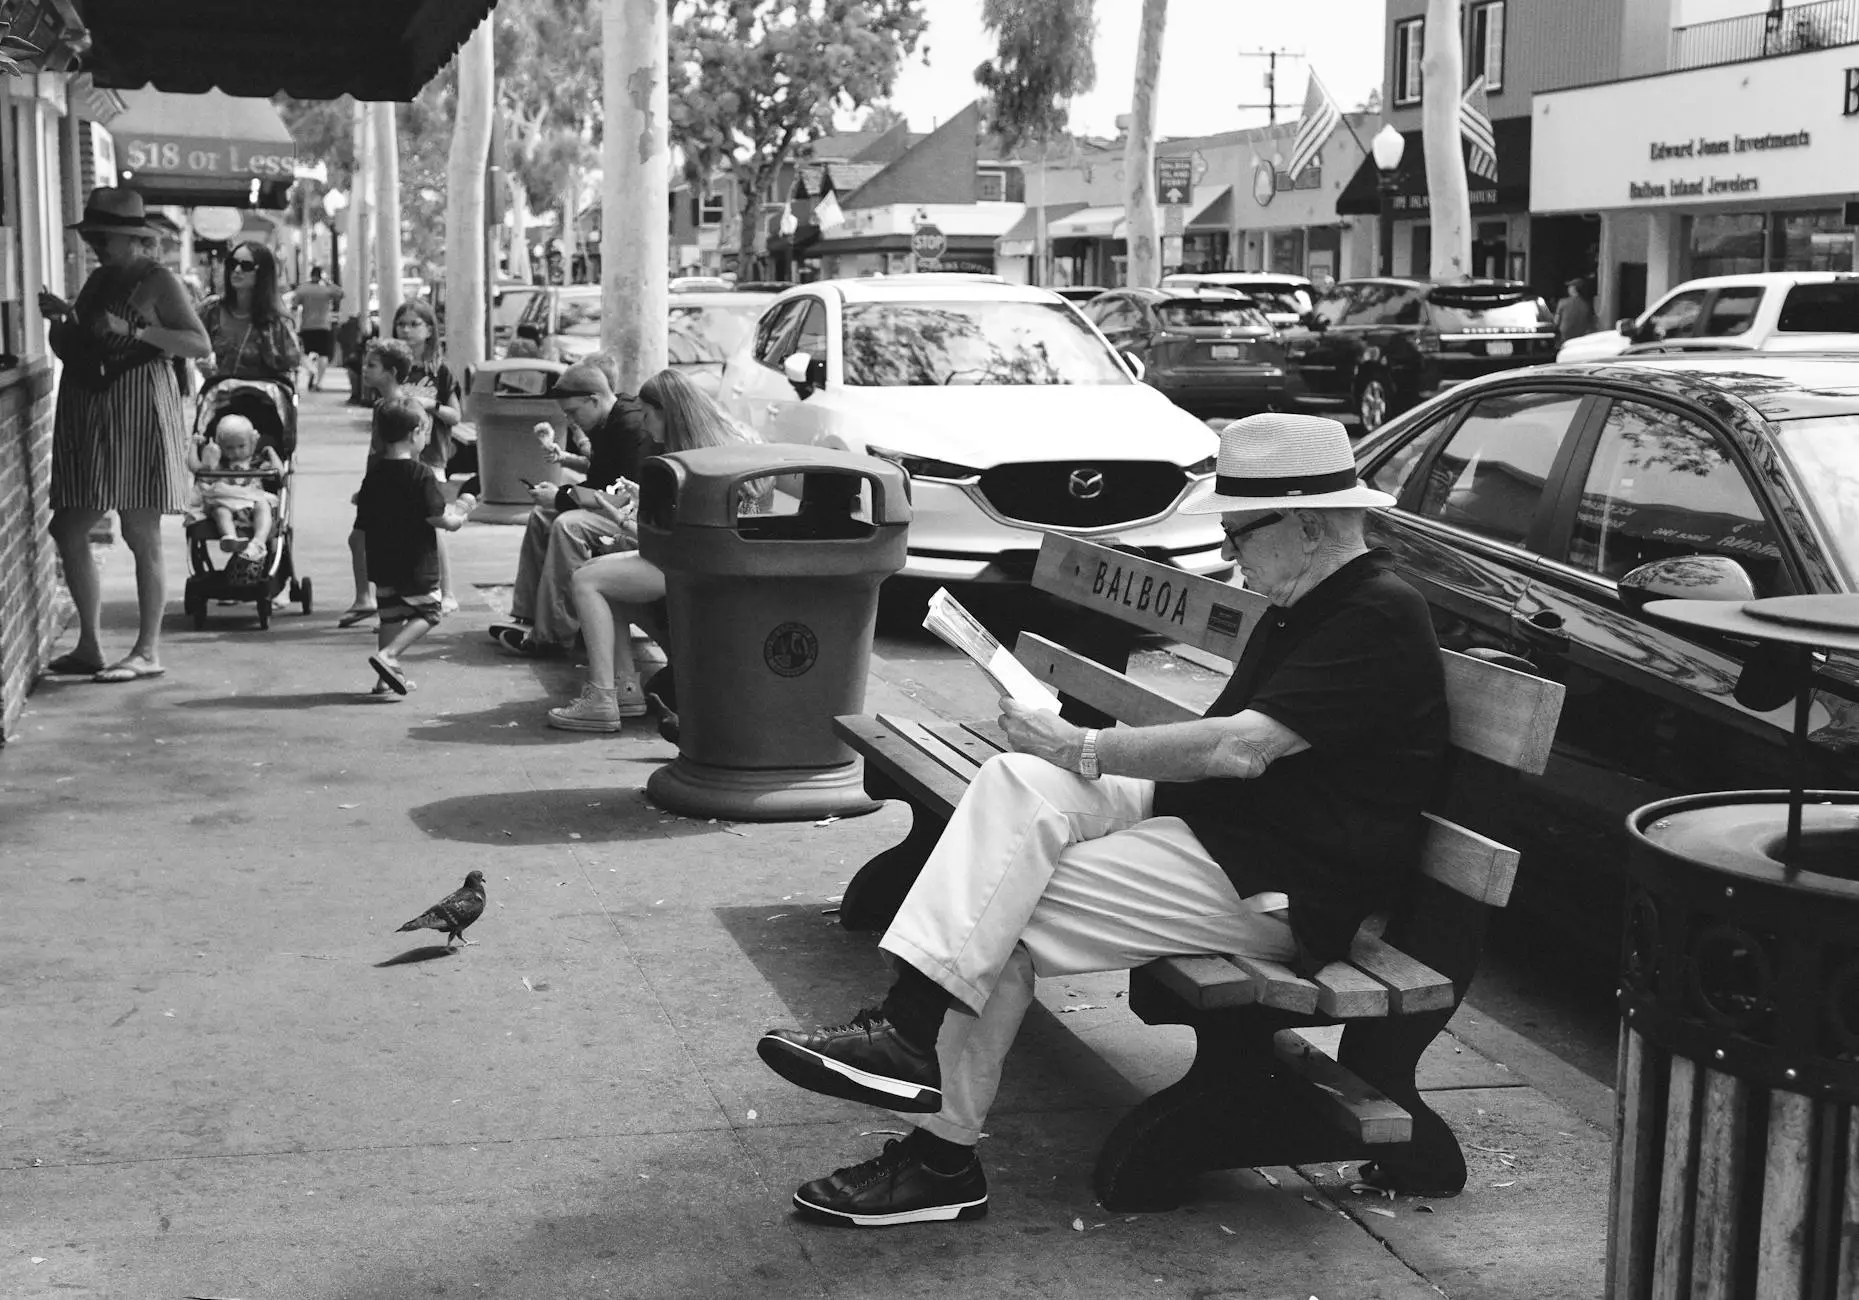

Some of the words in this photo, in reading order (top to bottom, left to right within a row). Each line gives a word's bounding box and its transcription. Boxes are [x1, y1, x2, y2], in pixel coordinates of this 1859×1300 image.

[127, 140, 180, 169] $18
[188, 150, 220, 171] or
[229, 145, 293, 175] Less
[1650, 139, 1693, 160] Edward
[1697, 136, 1729, 156] Jones
[1734, 129, 1810, 152] Investments
[1670, 177, 1703, 196] Island
[1707, 173, 1758, 194] Jewelers
[914, 234, 943, 250] STOP
[1092, 561, 1188, 625] BALBOA
